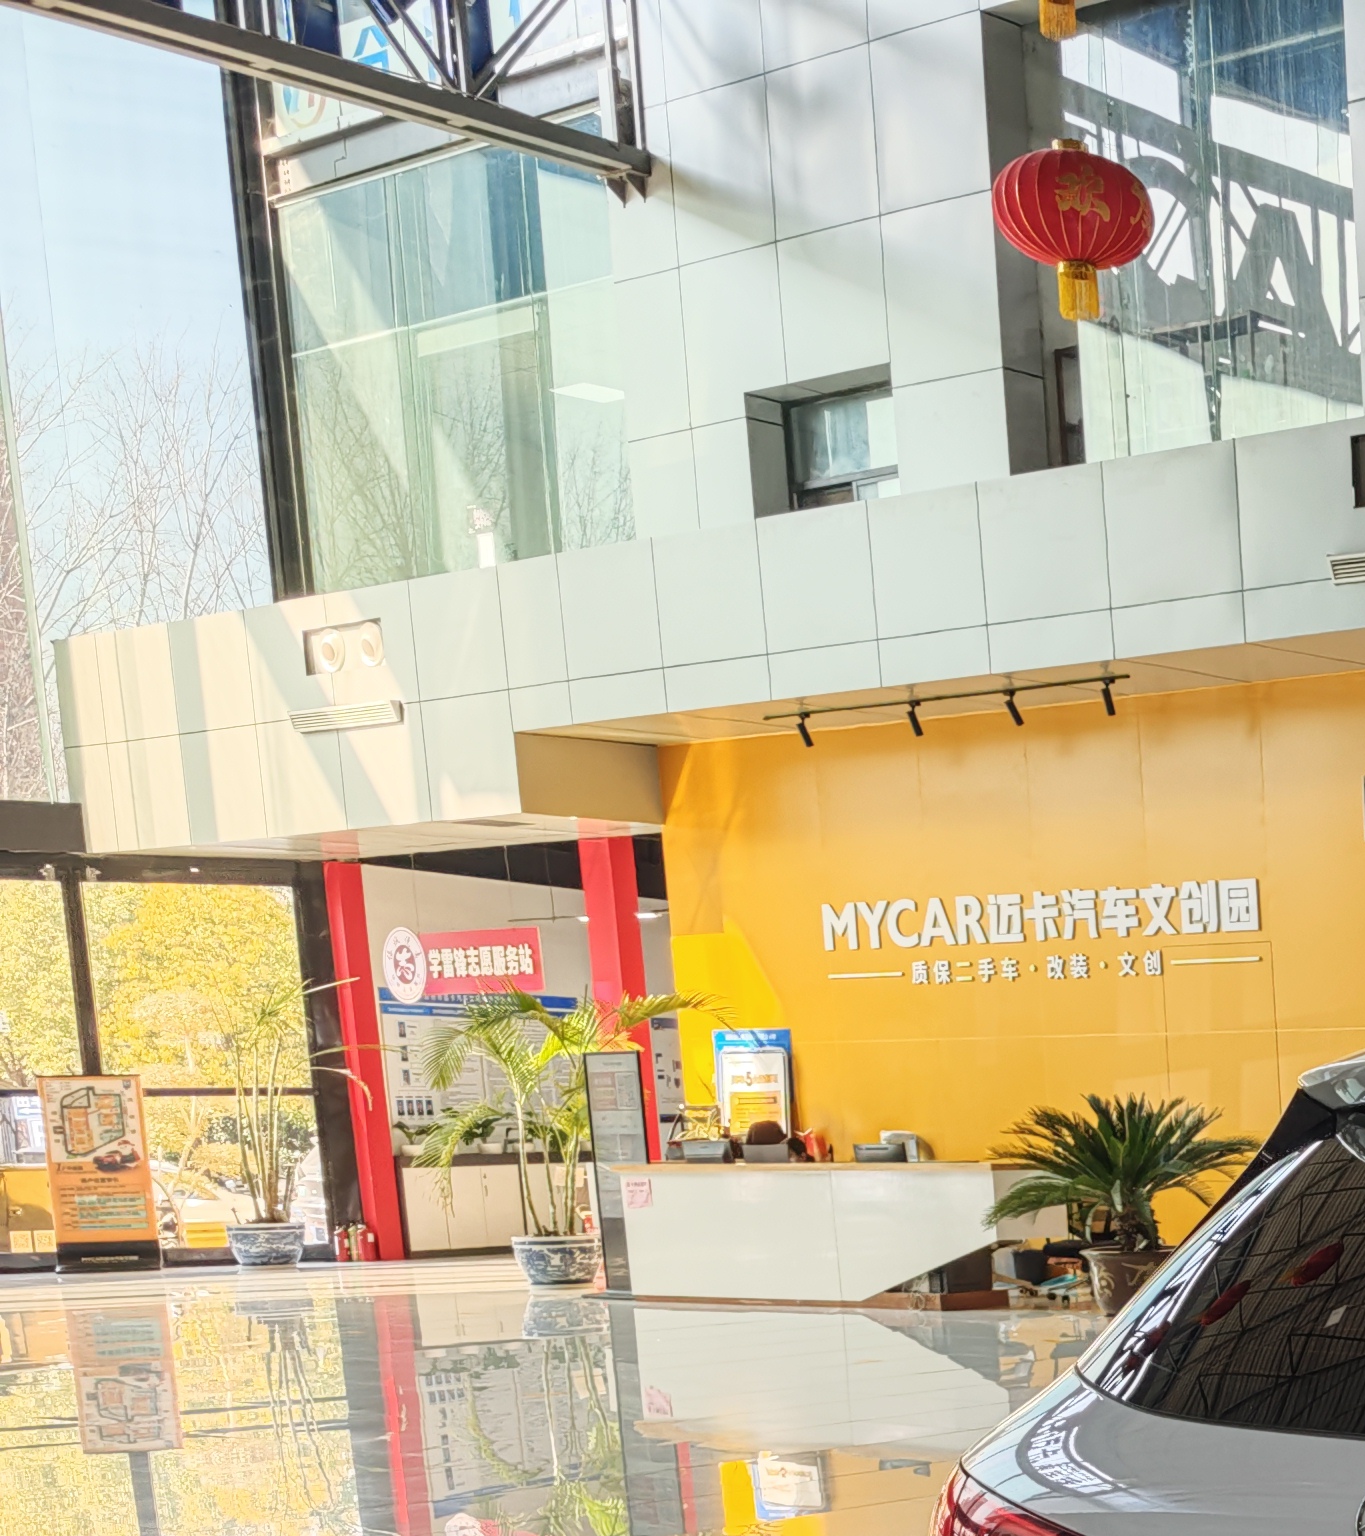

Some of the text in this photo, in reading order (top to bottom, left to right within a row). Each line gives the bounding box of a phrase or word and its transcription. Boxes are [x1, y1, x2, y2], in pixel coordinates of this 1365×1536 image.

[821, 877, 1260, 952] MYCAR迈卡汽车文创园
[428, 943, 534, 979] 学雷锋志愿服务站
